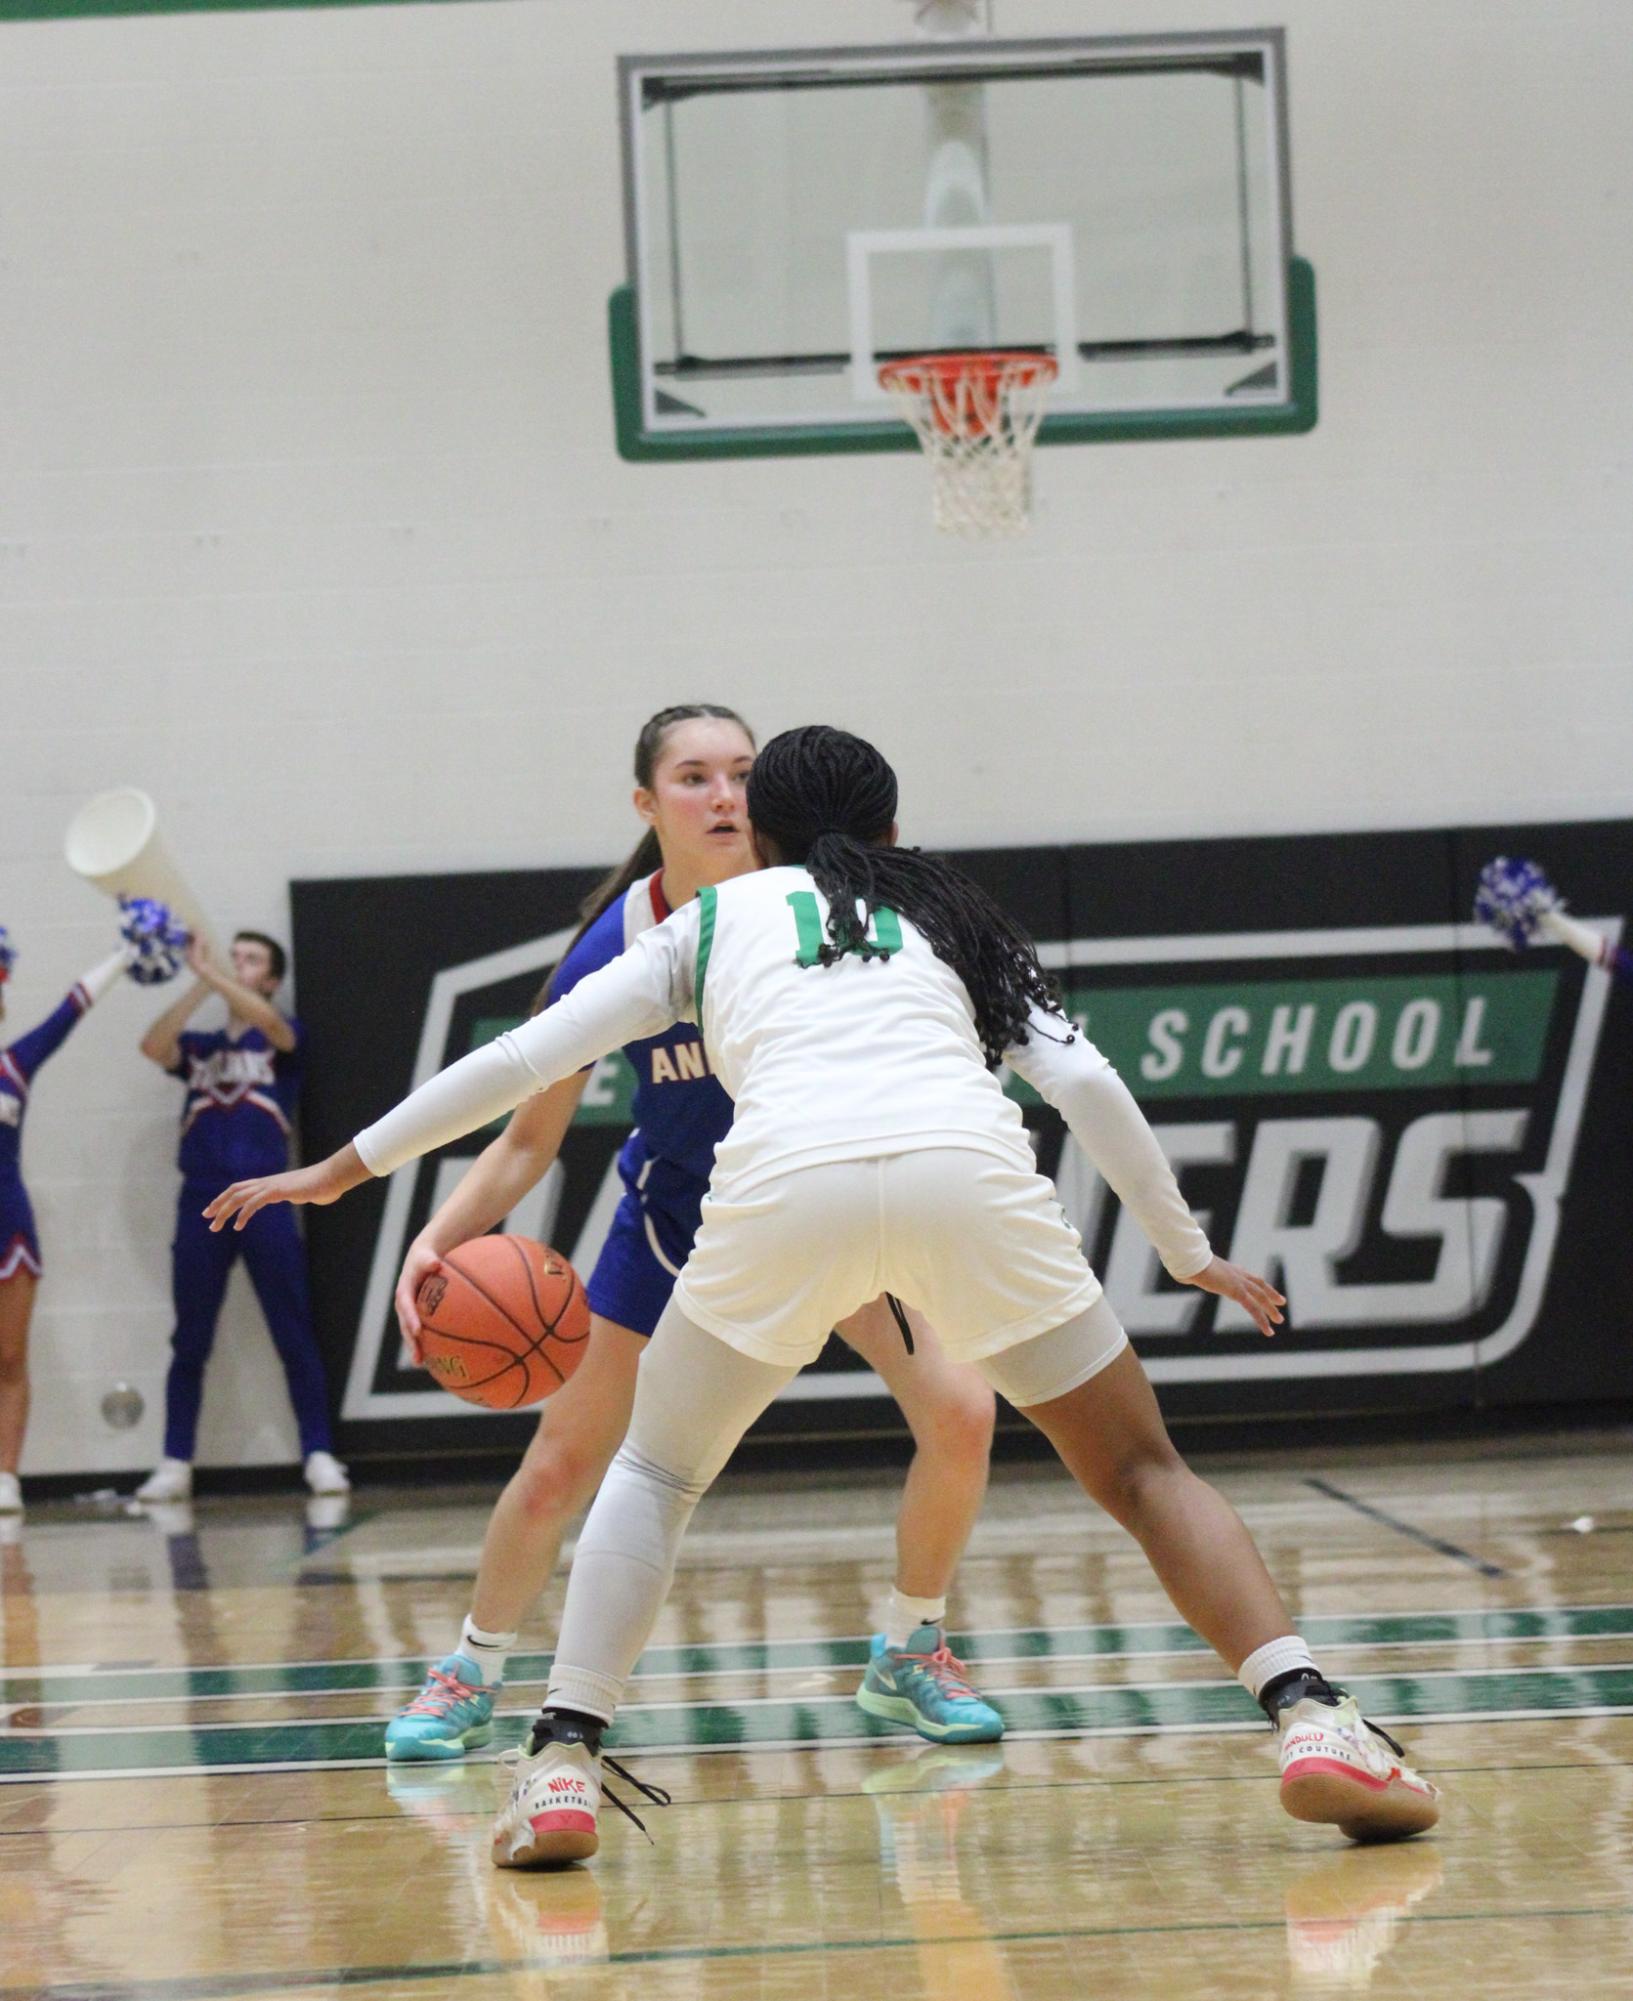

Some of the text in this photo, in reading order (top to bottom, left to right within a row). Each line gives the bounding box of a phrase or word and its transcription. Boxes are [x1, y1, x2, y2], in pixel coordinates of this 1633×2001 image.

[1141, 996, 1495, 1082] SCHOOL
[651, 1041, 714, 1085] AN
[1055, 1108, 1532, 1340] ERS
[1299, 1745, 1350, 1761] COUTURE
[548, 1776, 585, 1793] NIKE
